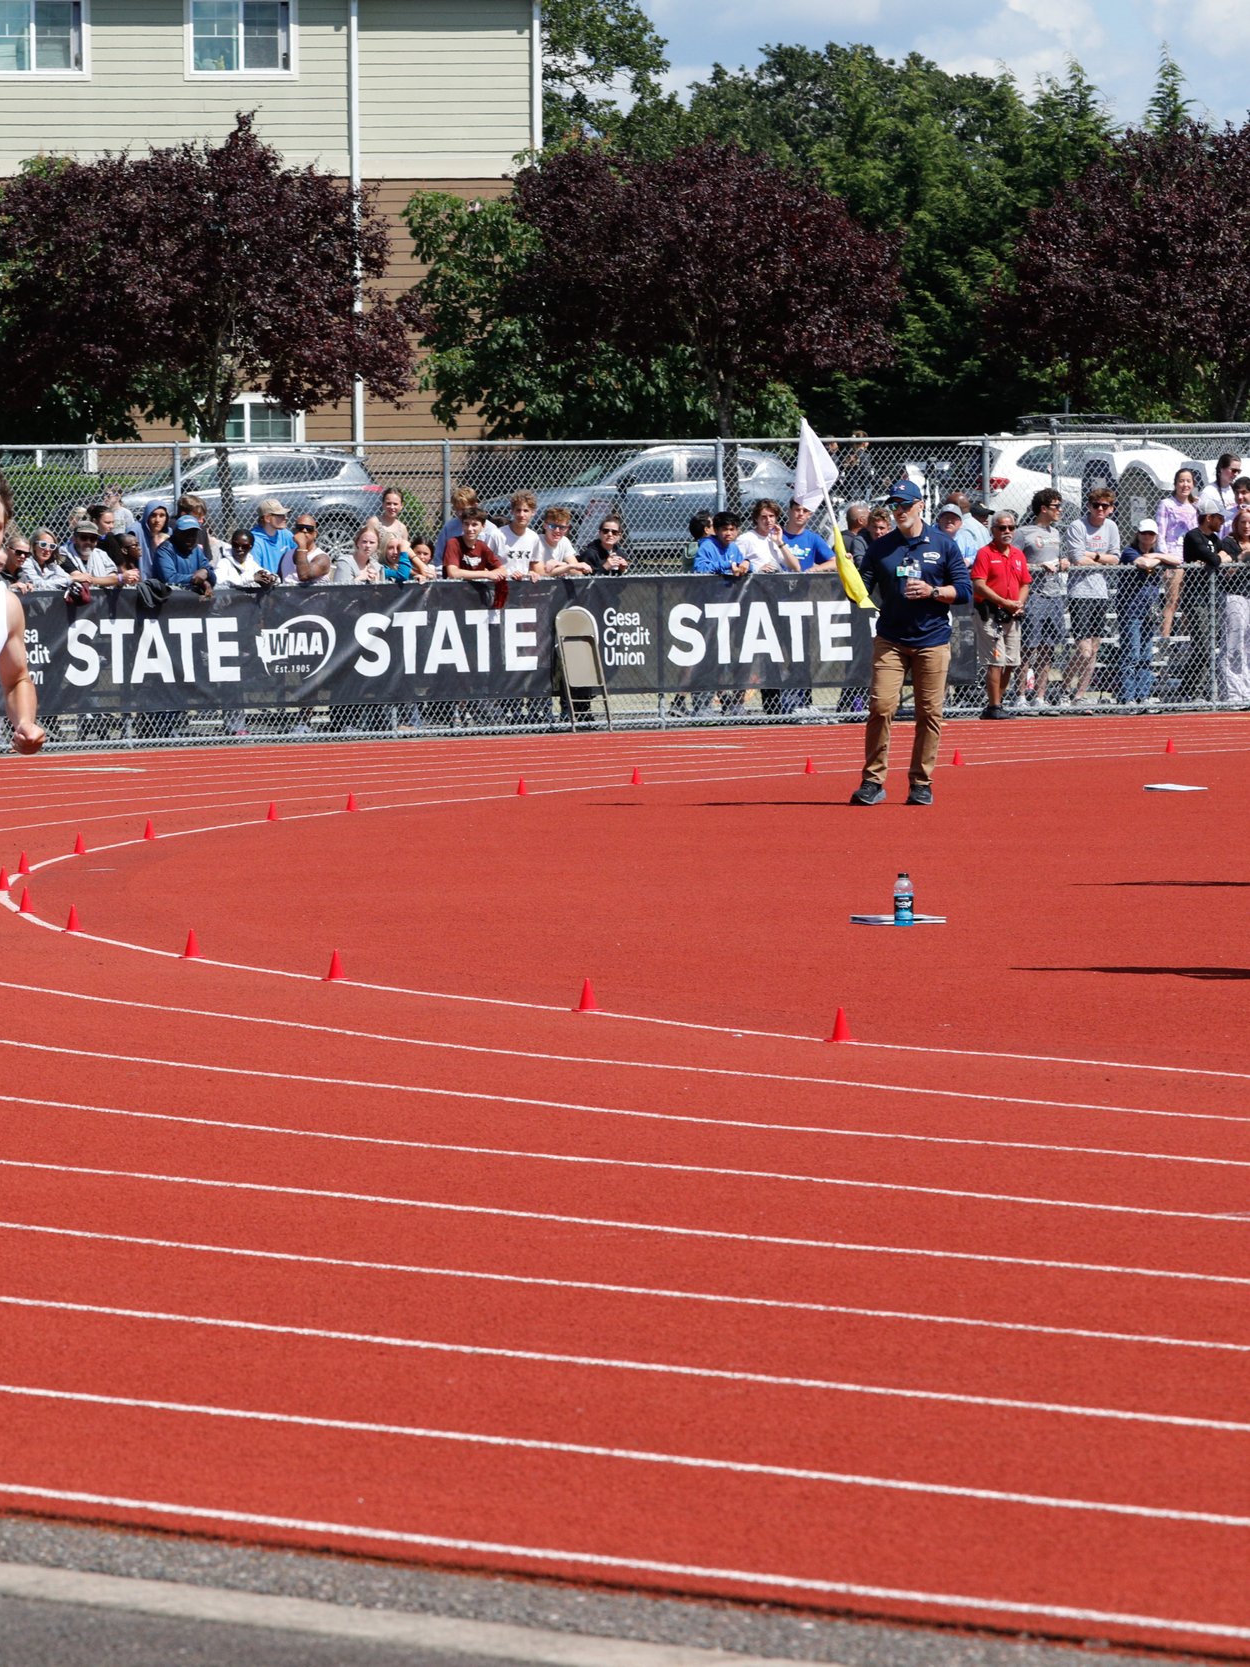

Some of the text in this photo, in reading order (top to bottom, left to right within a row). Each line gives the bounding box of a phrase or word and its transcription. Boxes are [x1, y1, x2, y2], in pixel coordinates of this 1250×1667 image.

[603, 607, 641, 627] Gesa
[268, 631, 324, 656] WIAA
[353, 608, 539, 677] STATE
[603, 627, 651, 647] Credit
[667, 600, 854, 667] STATE
[65, 616, 242, 687] STATE
[603, 647, 646, 666] Union
